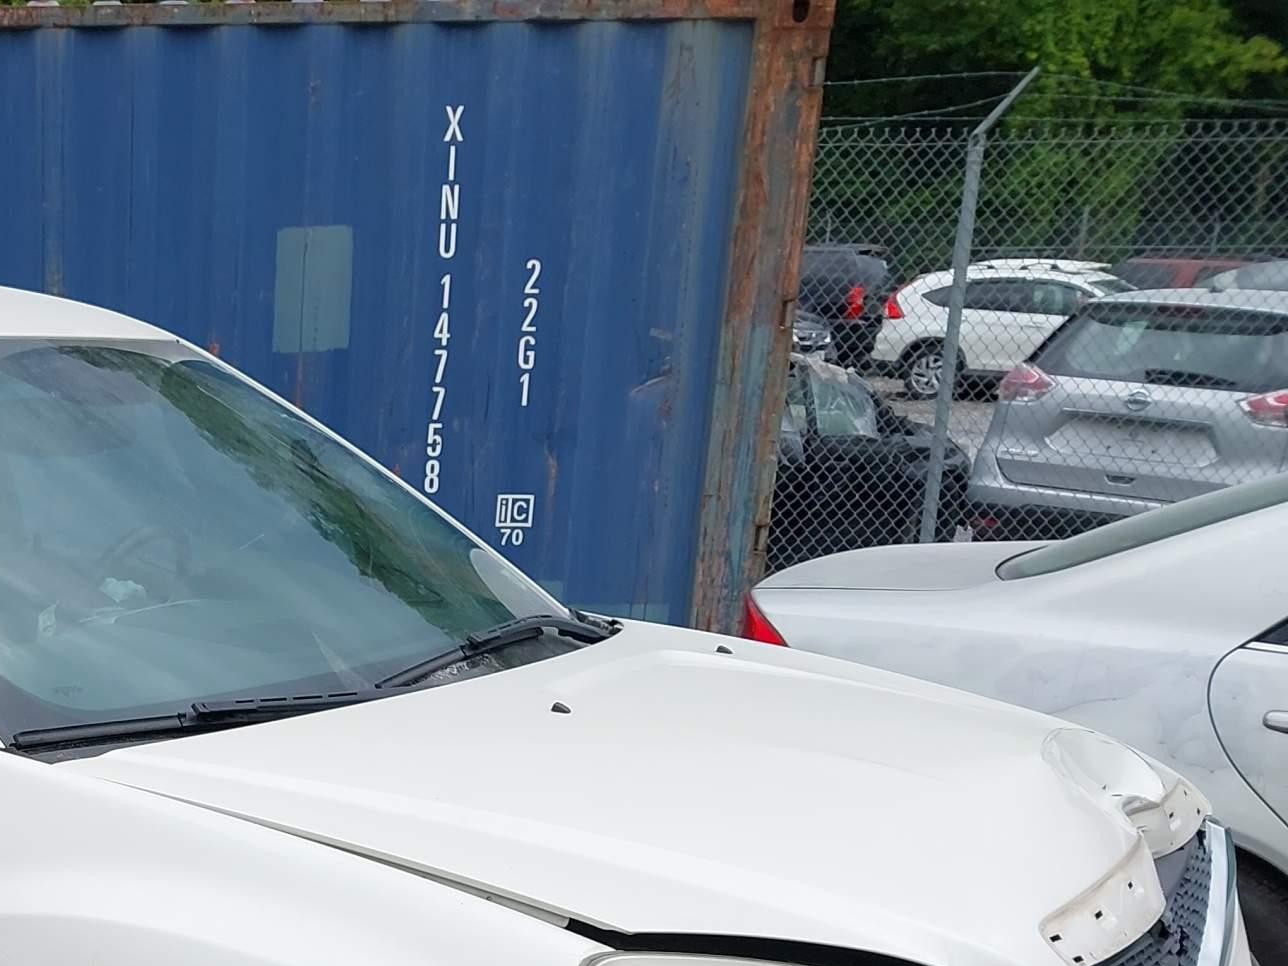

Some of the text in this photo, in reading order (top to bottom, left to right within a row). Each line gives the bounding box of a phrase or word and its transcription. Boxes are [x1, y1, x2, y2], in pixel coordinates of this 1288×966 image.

[424, 105, 464, 494] XINU 1477758
[518, 259, 541, 406] 22G1
[500, 528, 523, 546] 70
